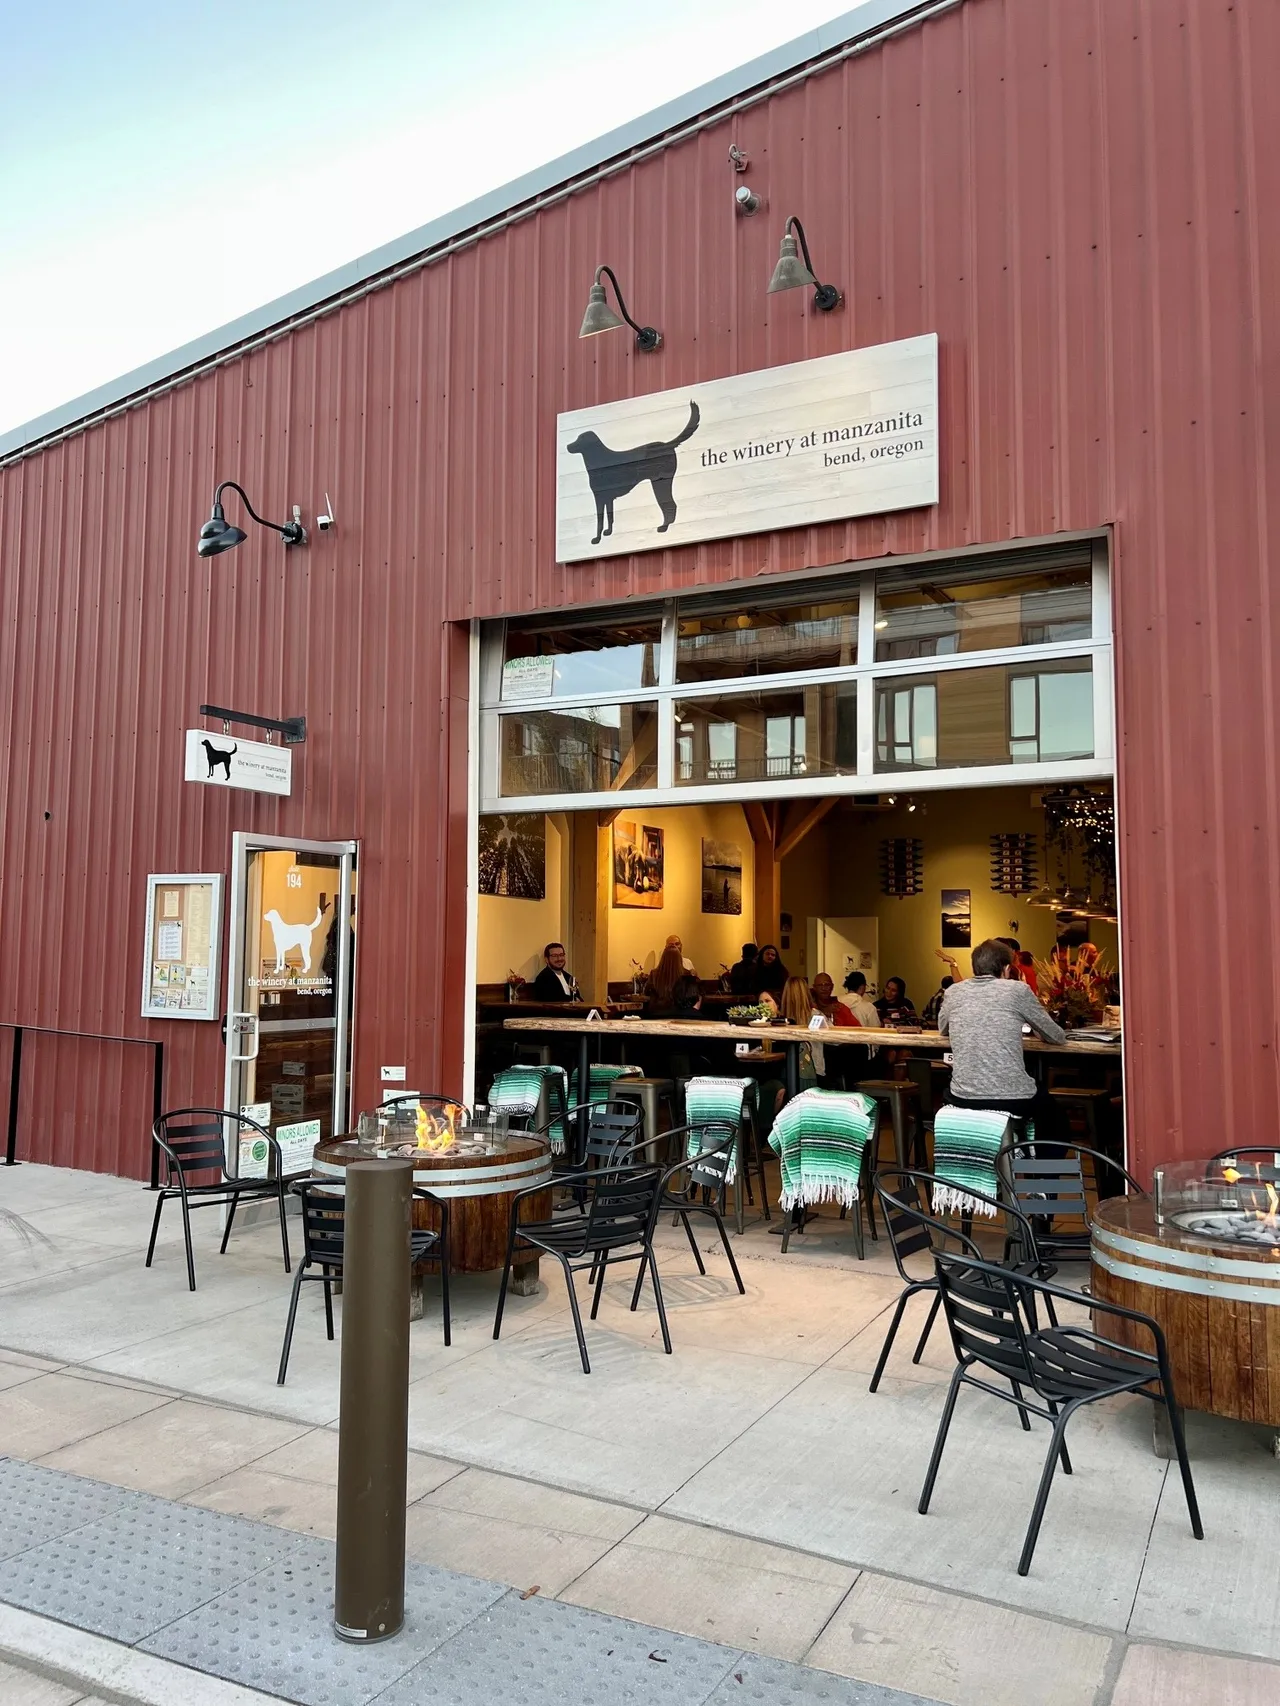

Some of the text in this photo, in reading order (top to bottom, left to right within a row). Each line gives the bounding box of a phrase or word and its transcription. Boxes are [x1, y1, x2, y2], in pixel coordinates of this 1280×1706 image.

[700, 412, 924, 468] the winery at manzanita
[824, 439, 924, 468] bend, oregon
[286, 872, 302, 888] 194
[248, 976, 332, 988] the winery at manzanita
[296, 987, 332, 996] bend, oregon
[297, 1122, 319, 1136] ALLOWED
